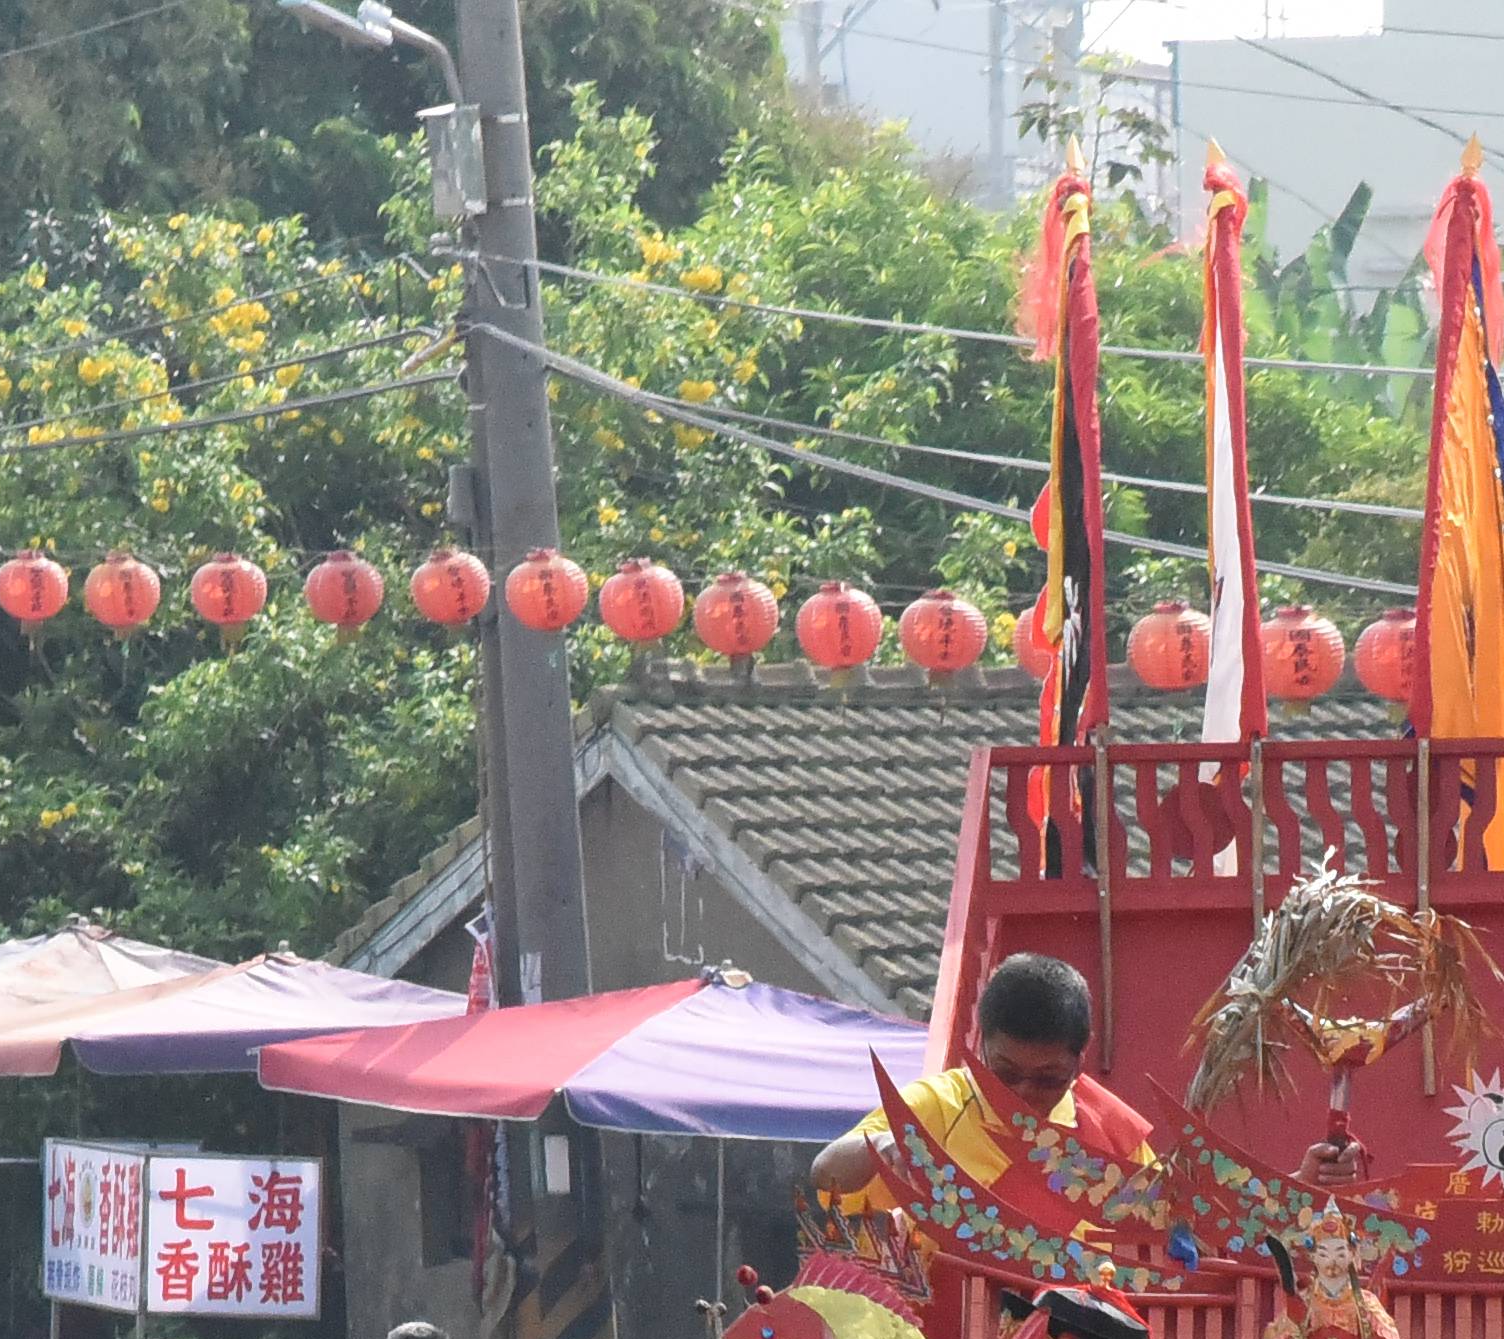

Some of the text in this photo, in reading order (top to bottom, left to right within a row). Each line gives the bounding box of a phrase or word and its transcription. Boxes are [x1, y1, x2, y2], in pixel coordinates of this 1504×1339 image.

[158, 1167, 305, 1235] 七海
[155, 1238, 305, 1305] 香酥雞
